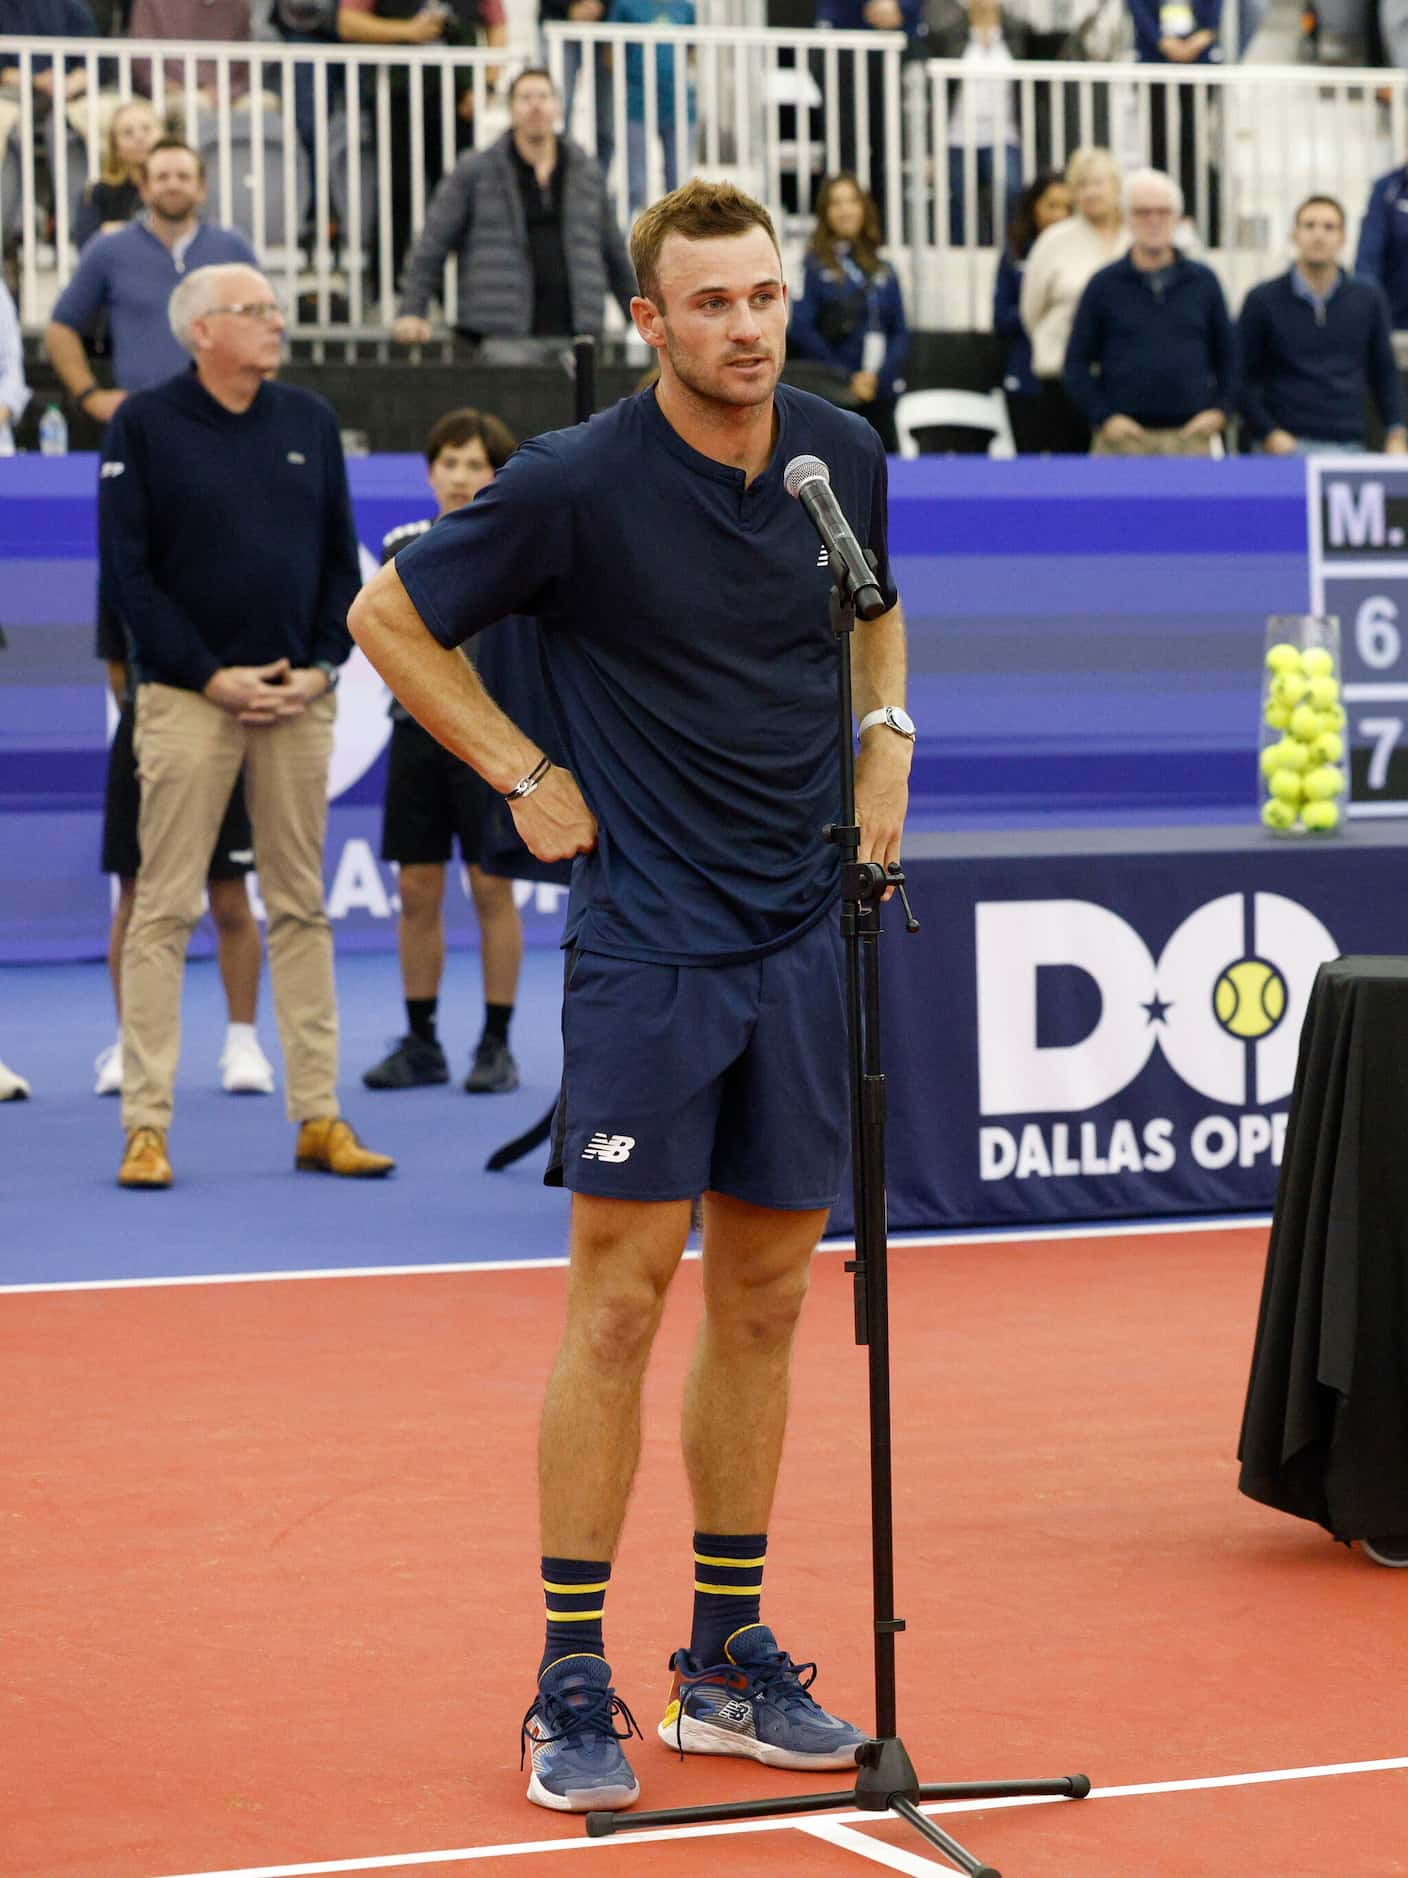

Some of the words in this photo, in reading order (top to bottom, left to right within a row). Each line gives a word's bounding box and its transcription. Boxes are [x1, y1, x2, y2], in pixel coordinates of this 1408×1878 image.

[1327, 481, 1405, 547] M.
[1355, 594, 1401, 669] 6
[1358, 717, 1404, 791] 7
[979, 1118, 1177, 1181] DALLAS
